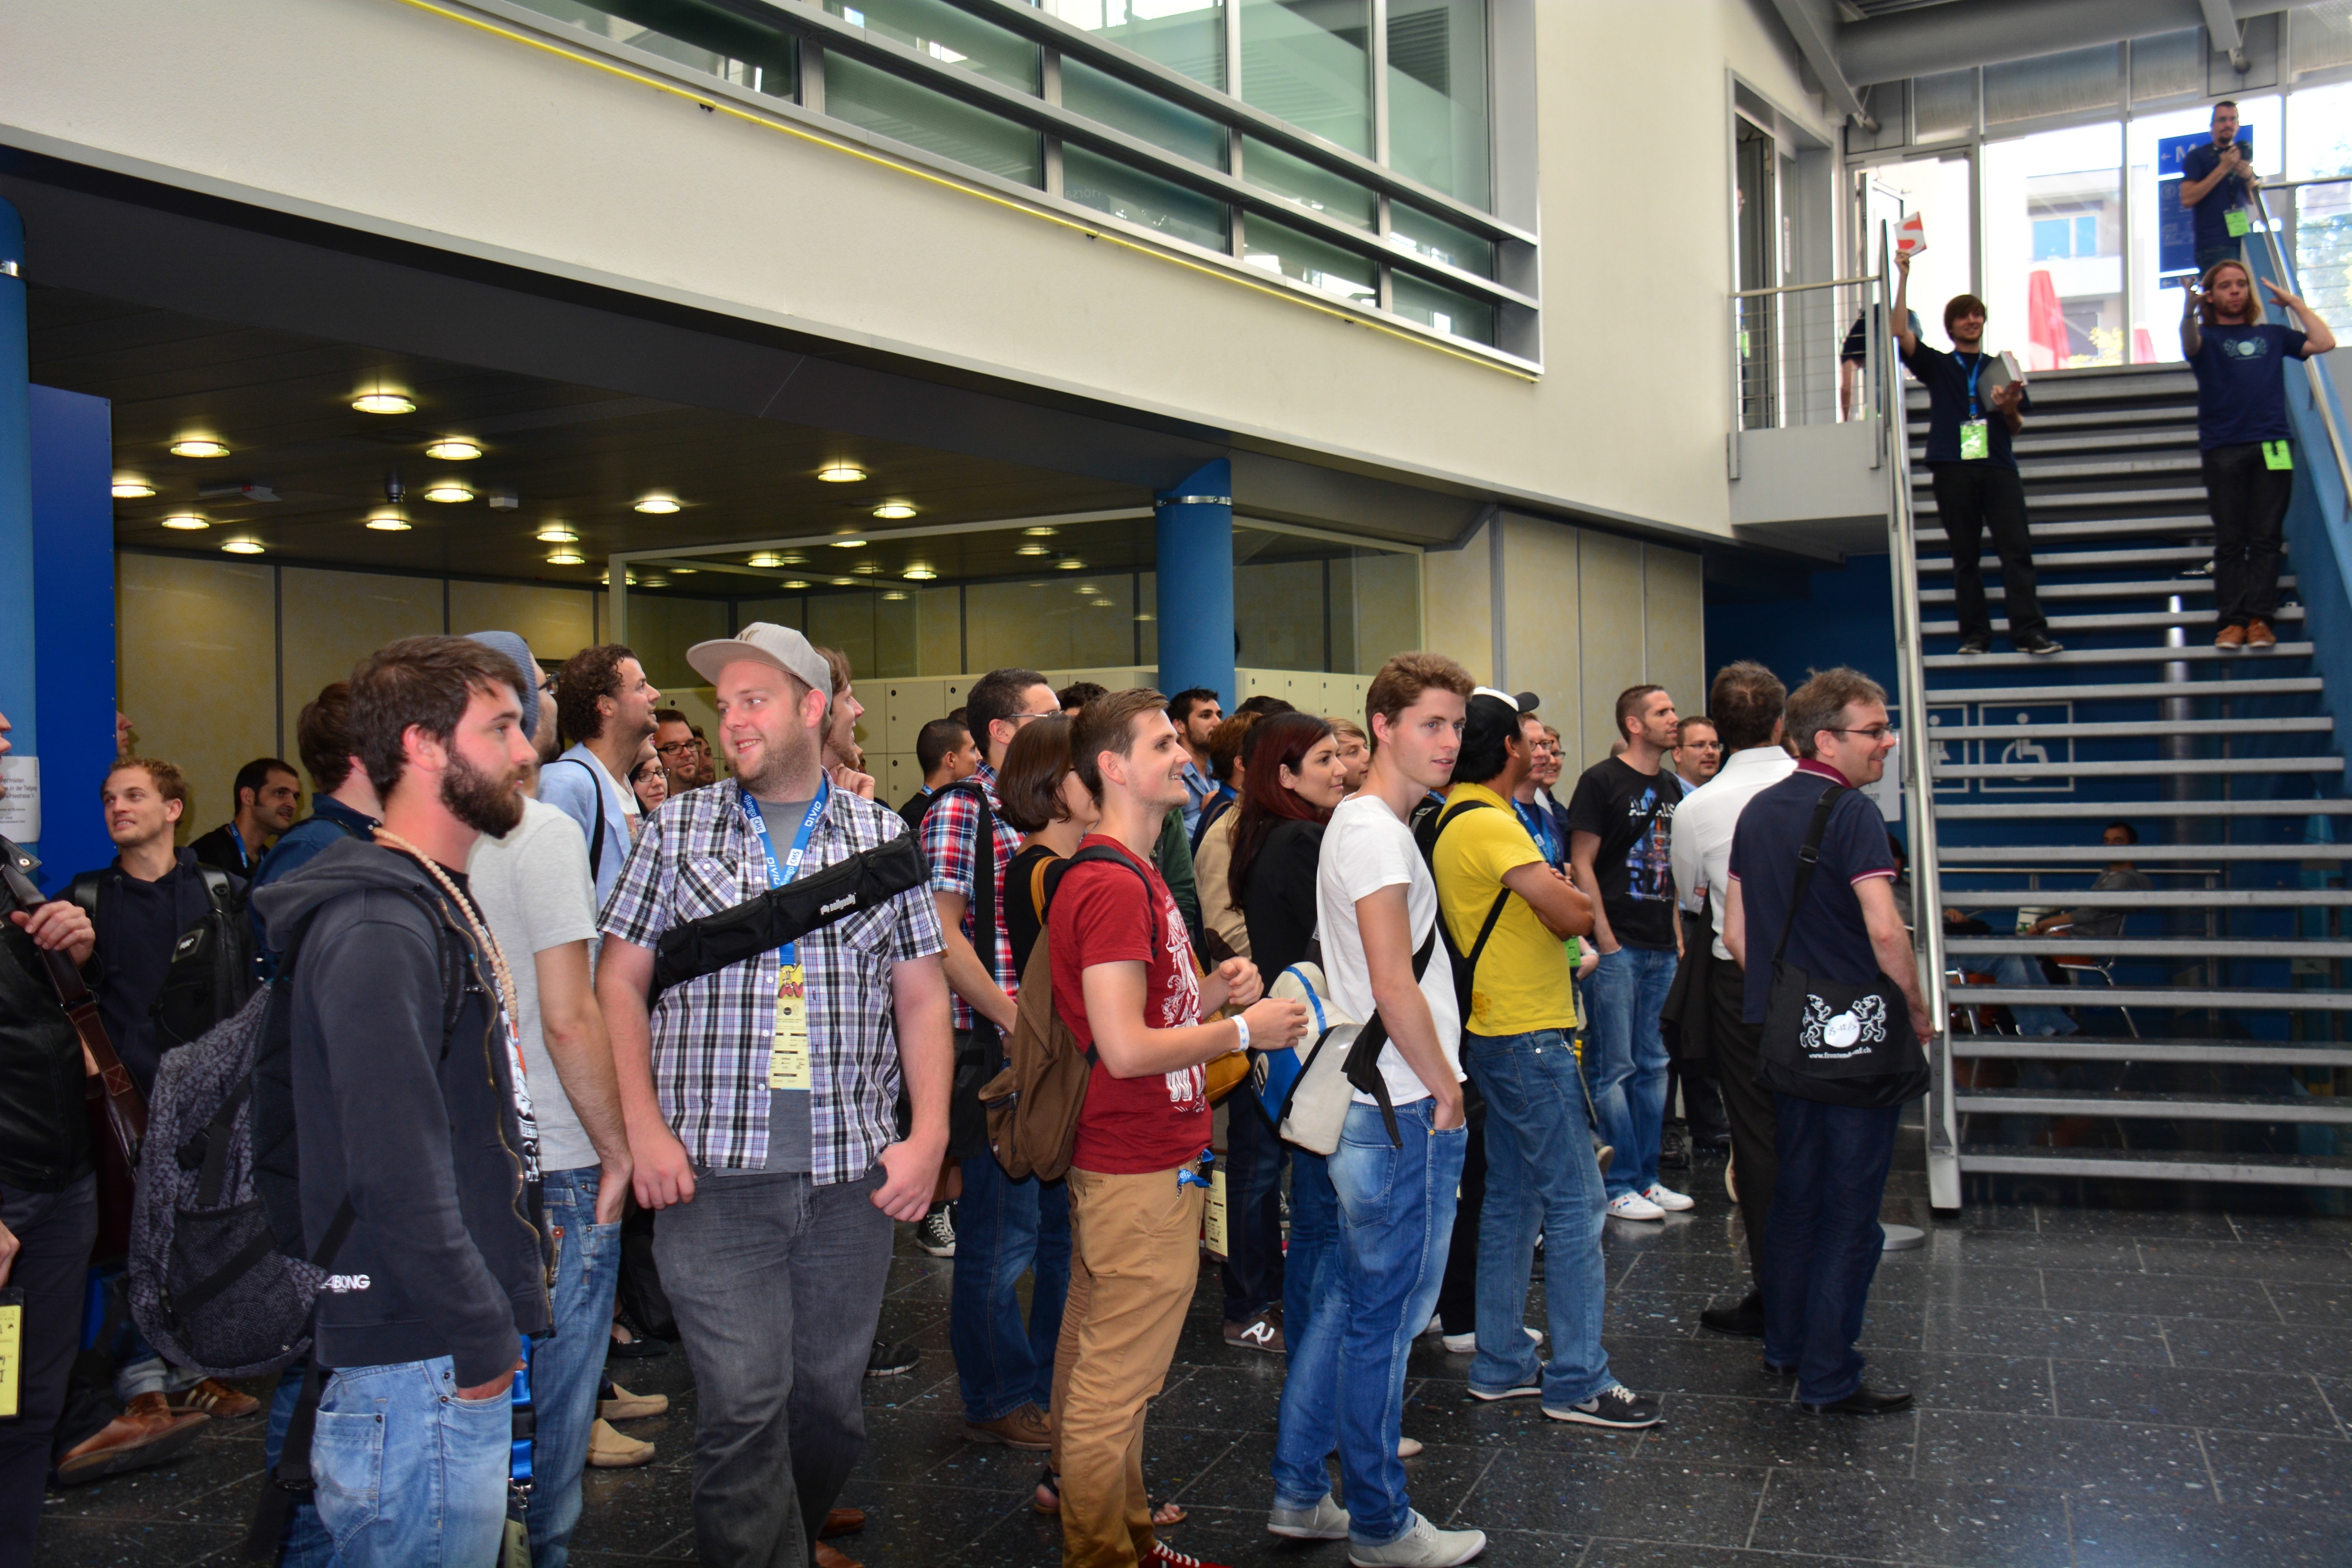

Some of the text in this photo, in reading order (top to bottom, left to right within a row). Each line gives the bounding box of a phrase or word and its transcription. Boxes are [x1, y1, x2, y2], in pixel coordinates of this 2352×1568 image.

[744, 794, 763, 832] django CMS
[804, 801, 822, 827] DIVIO
[790, 851, 800, 864] CMS
